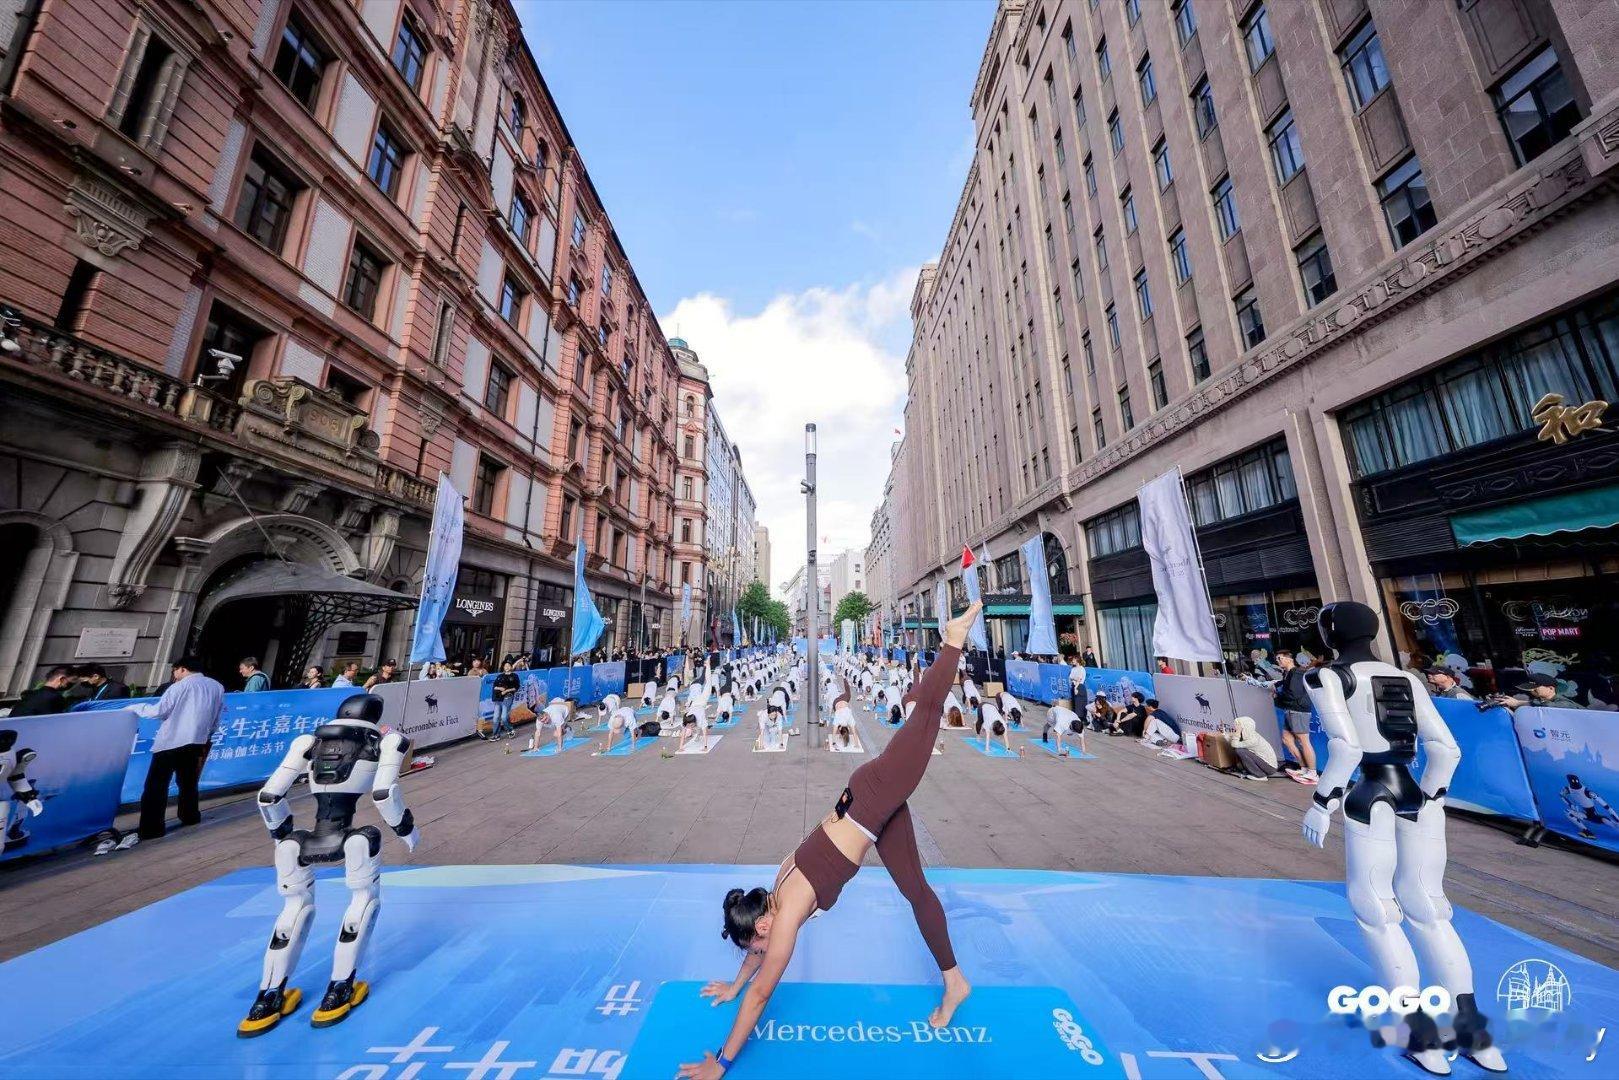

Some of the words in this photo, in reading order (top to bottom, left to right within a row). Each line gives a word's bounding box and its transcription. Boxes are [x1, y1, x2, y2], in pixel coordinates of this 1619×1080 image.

[1531, 393, 1608, 445] 和
[456, 598, 494, 611] LONGINES
[748, 1019, 993, 1044] Mercedes-Benz
[1052, 1008, 1104, 1066] GOGO
